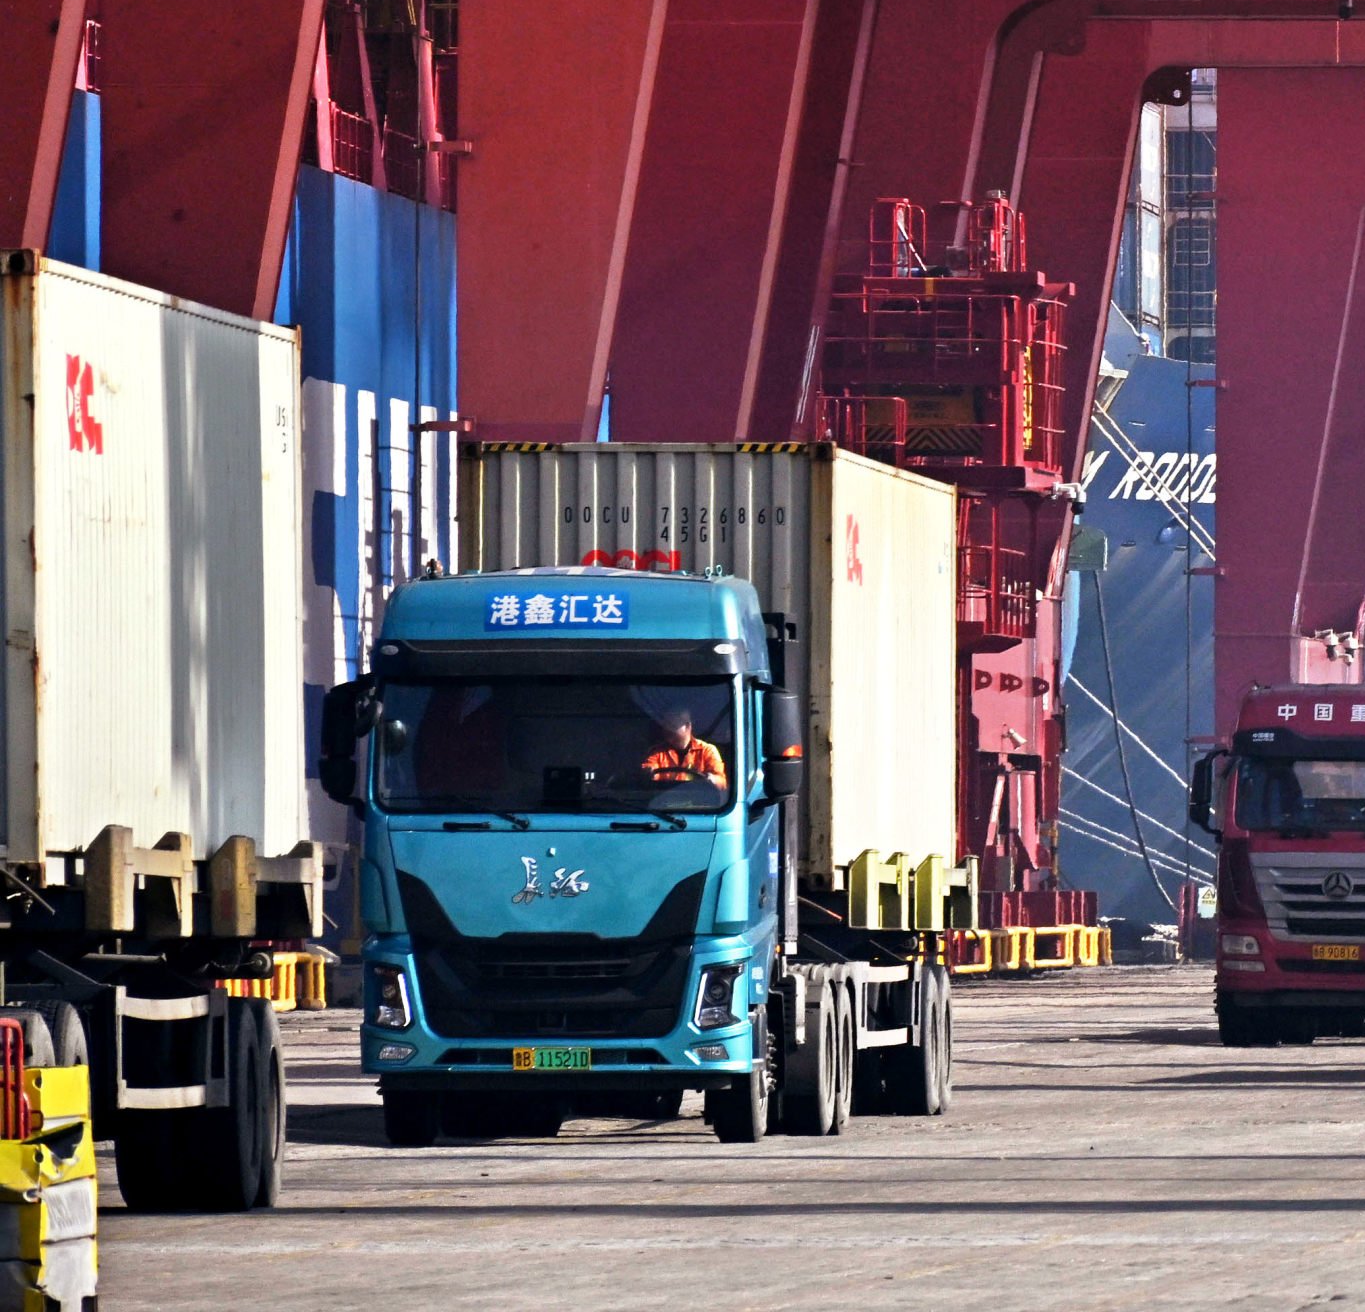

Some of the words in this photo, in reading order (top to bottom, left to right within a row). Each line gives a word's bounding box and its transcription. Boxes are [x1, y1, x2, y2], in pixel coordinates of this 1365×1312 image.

[661, 507, 786, 525] 7326860
[660, 527, 727, 543] 45G1
[490, 595, 624, 625] 港鑫汇达
